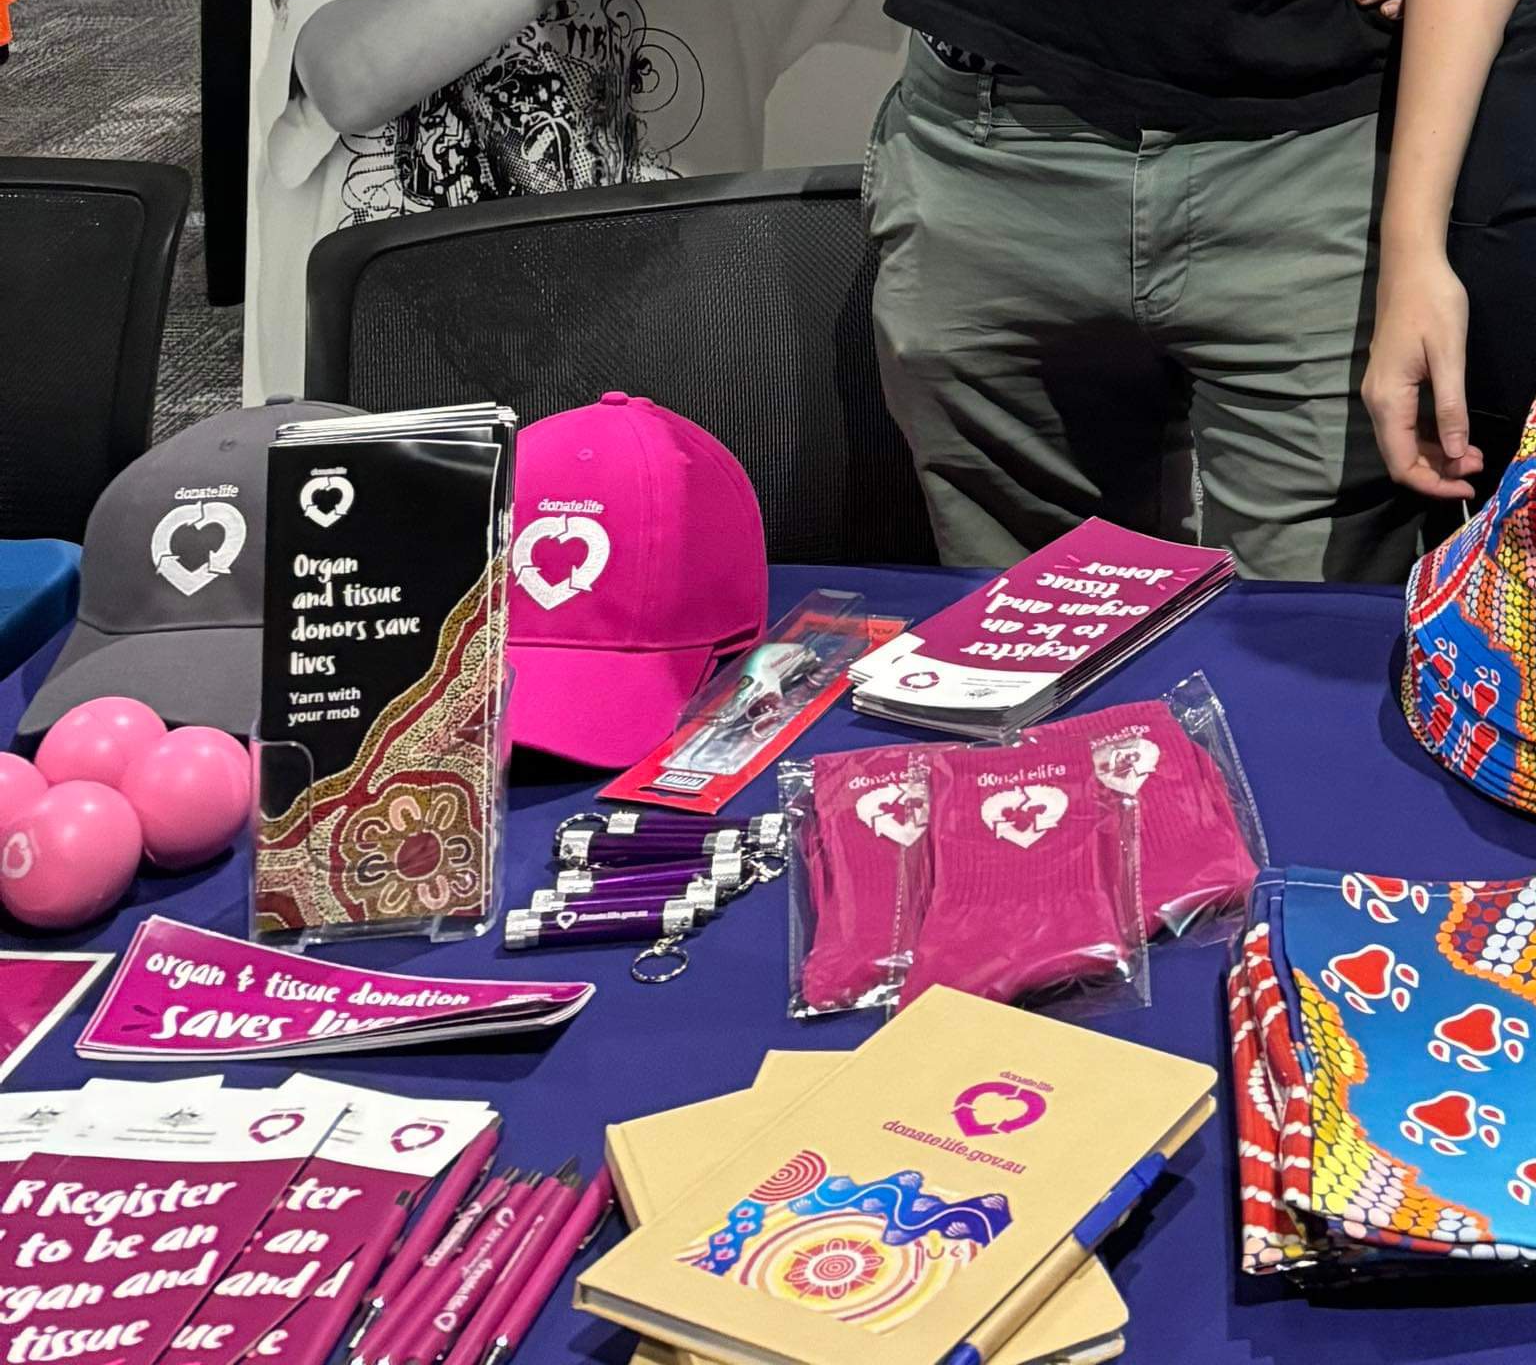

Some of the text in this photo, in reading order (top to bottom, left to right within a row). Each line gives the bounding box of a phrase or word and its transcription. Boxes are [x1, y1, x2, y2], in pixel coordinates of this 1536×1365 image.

[537, 498, 605, 515] donatelife
[293, 553, 359, 584] Organ
[1078, 560, 1174, 586] donor
[291, 581, 403, 610] and tissue
[1035, 573, 1121, 599] tissue
[984, 591, 1150, 620] organ and
[290, 615, 422, 643] donors save
[979, 616, 1109, 640] to be an
[290, 651, 337, 676] lives
[959, 639, 1091, 663] Register
[288, 686, 361, 706] Yarn with
[287, 704, 361, 727] your mob
[145, 953, 226, 990] organ
[265, 973, 341, 1004] tissue
[347, 981, 470, 1007] donation
[150, 1004, 293, 1042] saves
[881, 1119, 1028, 1176] donatelife.gov.au
[37, 1180, 238, 1227] Register
[15, 1224, 219, 1268] to be an
[112, 1250, 220, 1299] and
[6, 1320, 150, 1364] tissue
